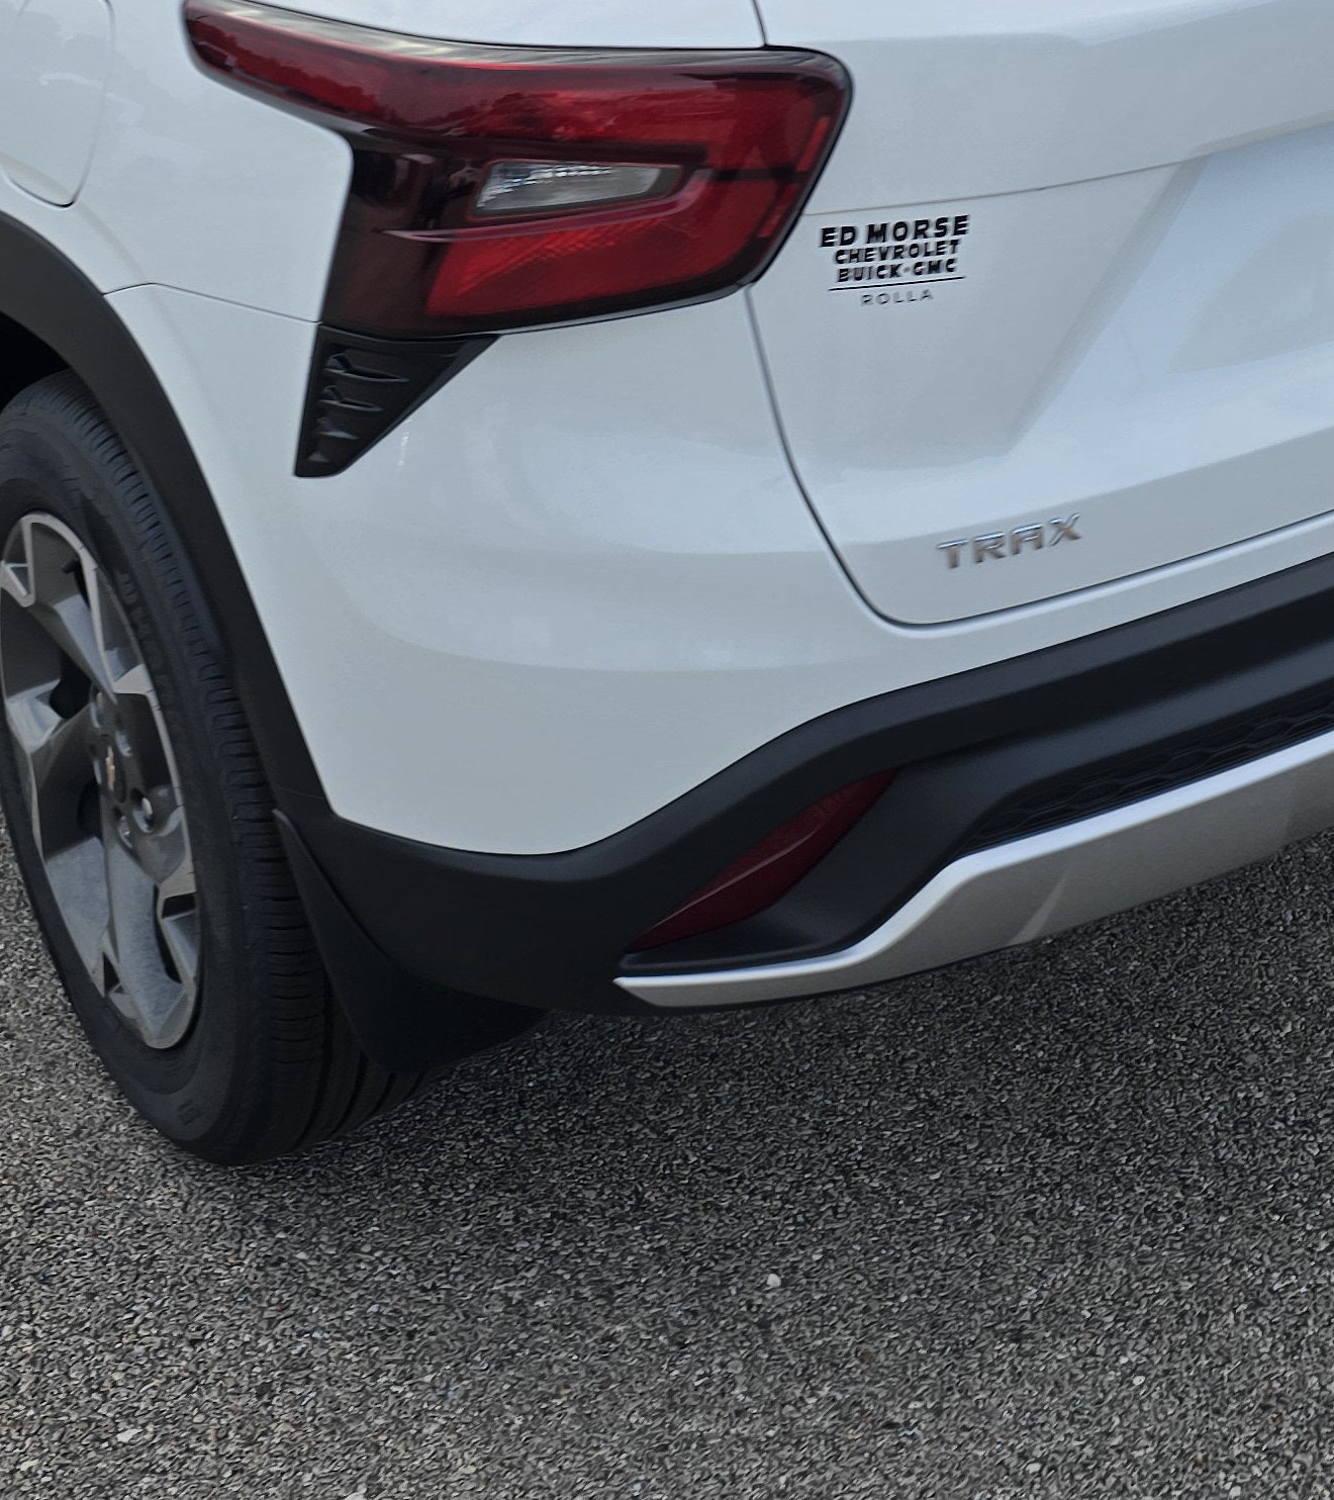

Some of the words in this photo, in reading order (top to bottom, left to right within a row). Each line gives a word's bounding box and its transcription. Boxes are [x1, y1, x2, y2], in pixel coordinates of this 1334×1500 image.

[820, 226, 858, 247] ED
[865, 214, 970, 244] MORSE
[834, 239, 961, 264] CHEVROLET
[861, 289, 935, 306] ROLLA
[936, 512, 1083, 569] TRAX
